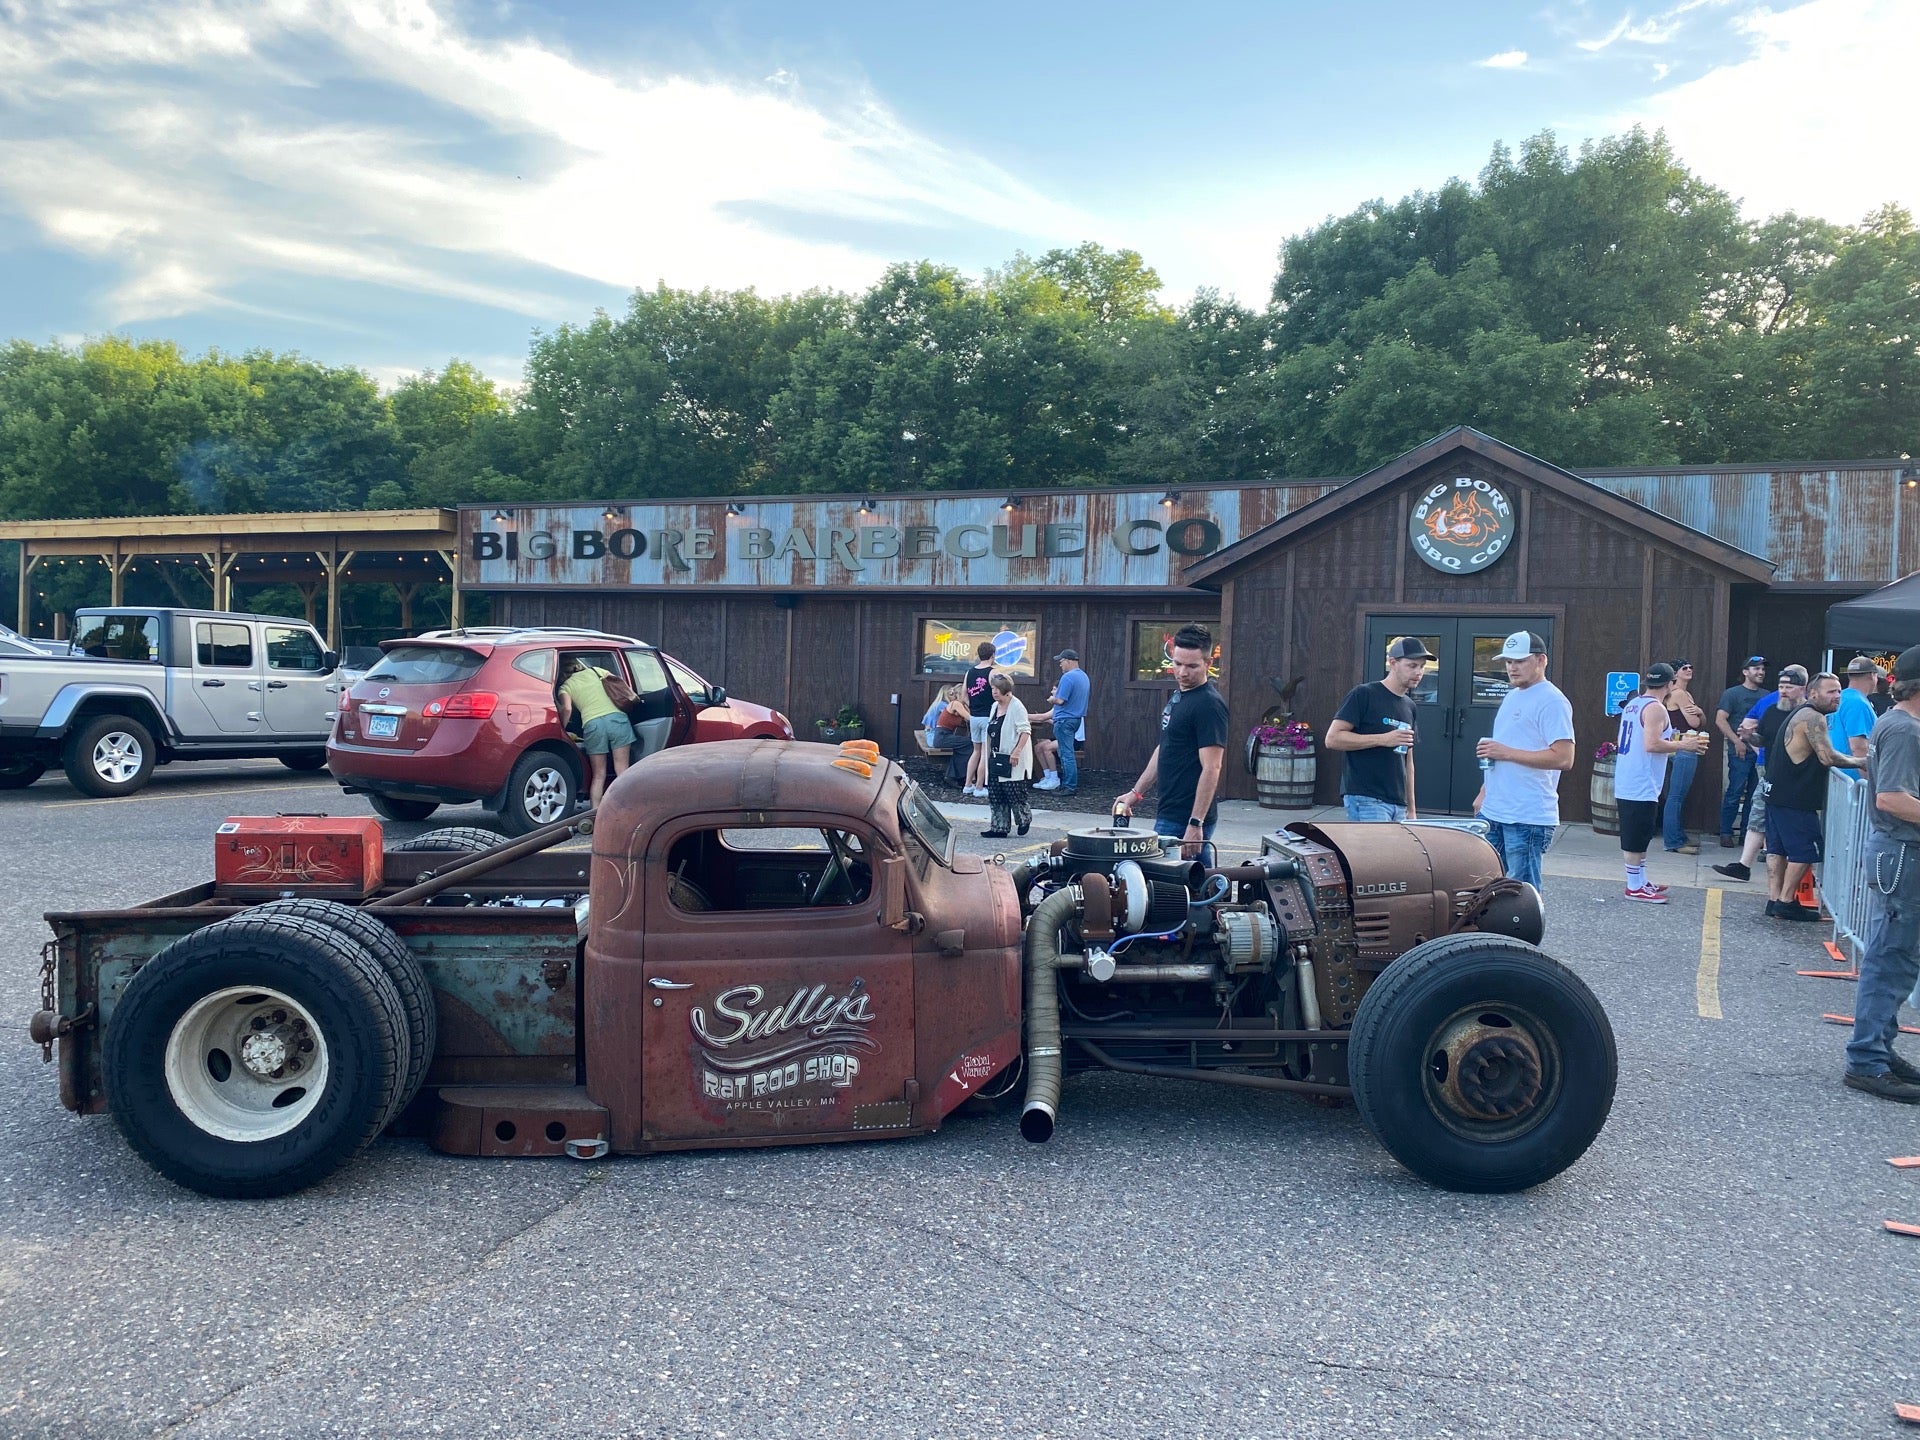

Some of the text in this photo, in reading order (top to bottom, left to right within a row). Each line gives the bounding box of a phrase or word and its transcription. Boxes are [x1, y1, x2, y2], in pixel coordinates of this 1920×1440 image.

[1415, 478, 1510, 520] BIG BORE
[472, 519, 1221, 571] BIG BORE BARBECUE CO
[1416, 533, 1461, 570] BBQ
[940, 640, 971, 660] Lite
[1356, 881, 1408, 895] DODGE
[690, 976, 876, 1048] Sully's
[752, 1062, 800, 1097] ROD
[804, 1054, 860, 1087] SHOP
[726, 1100, 762, 1110] APPLE
